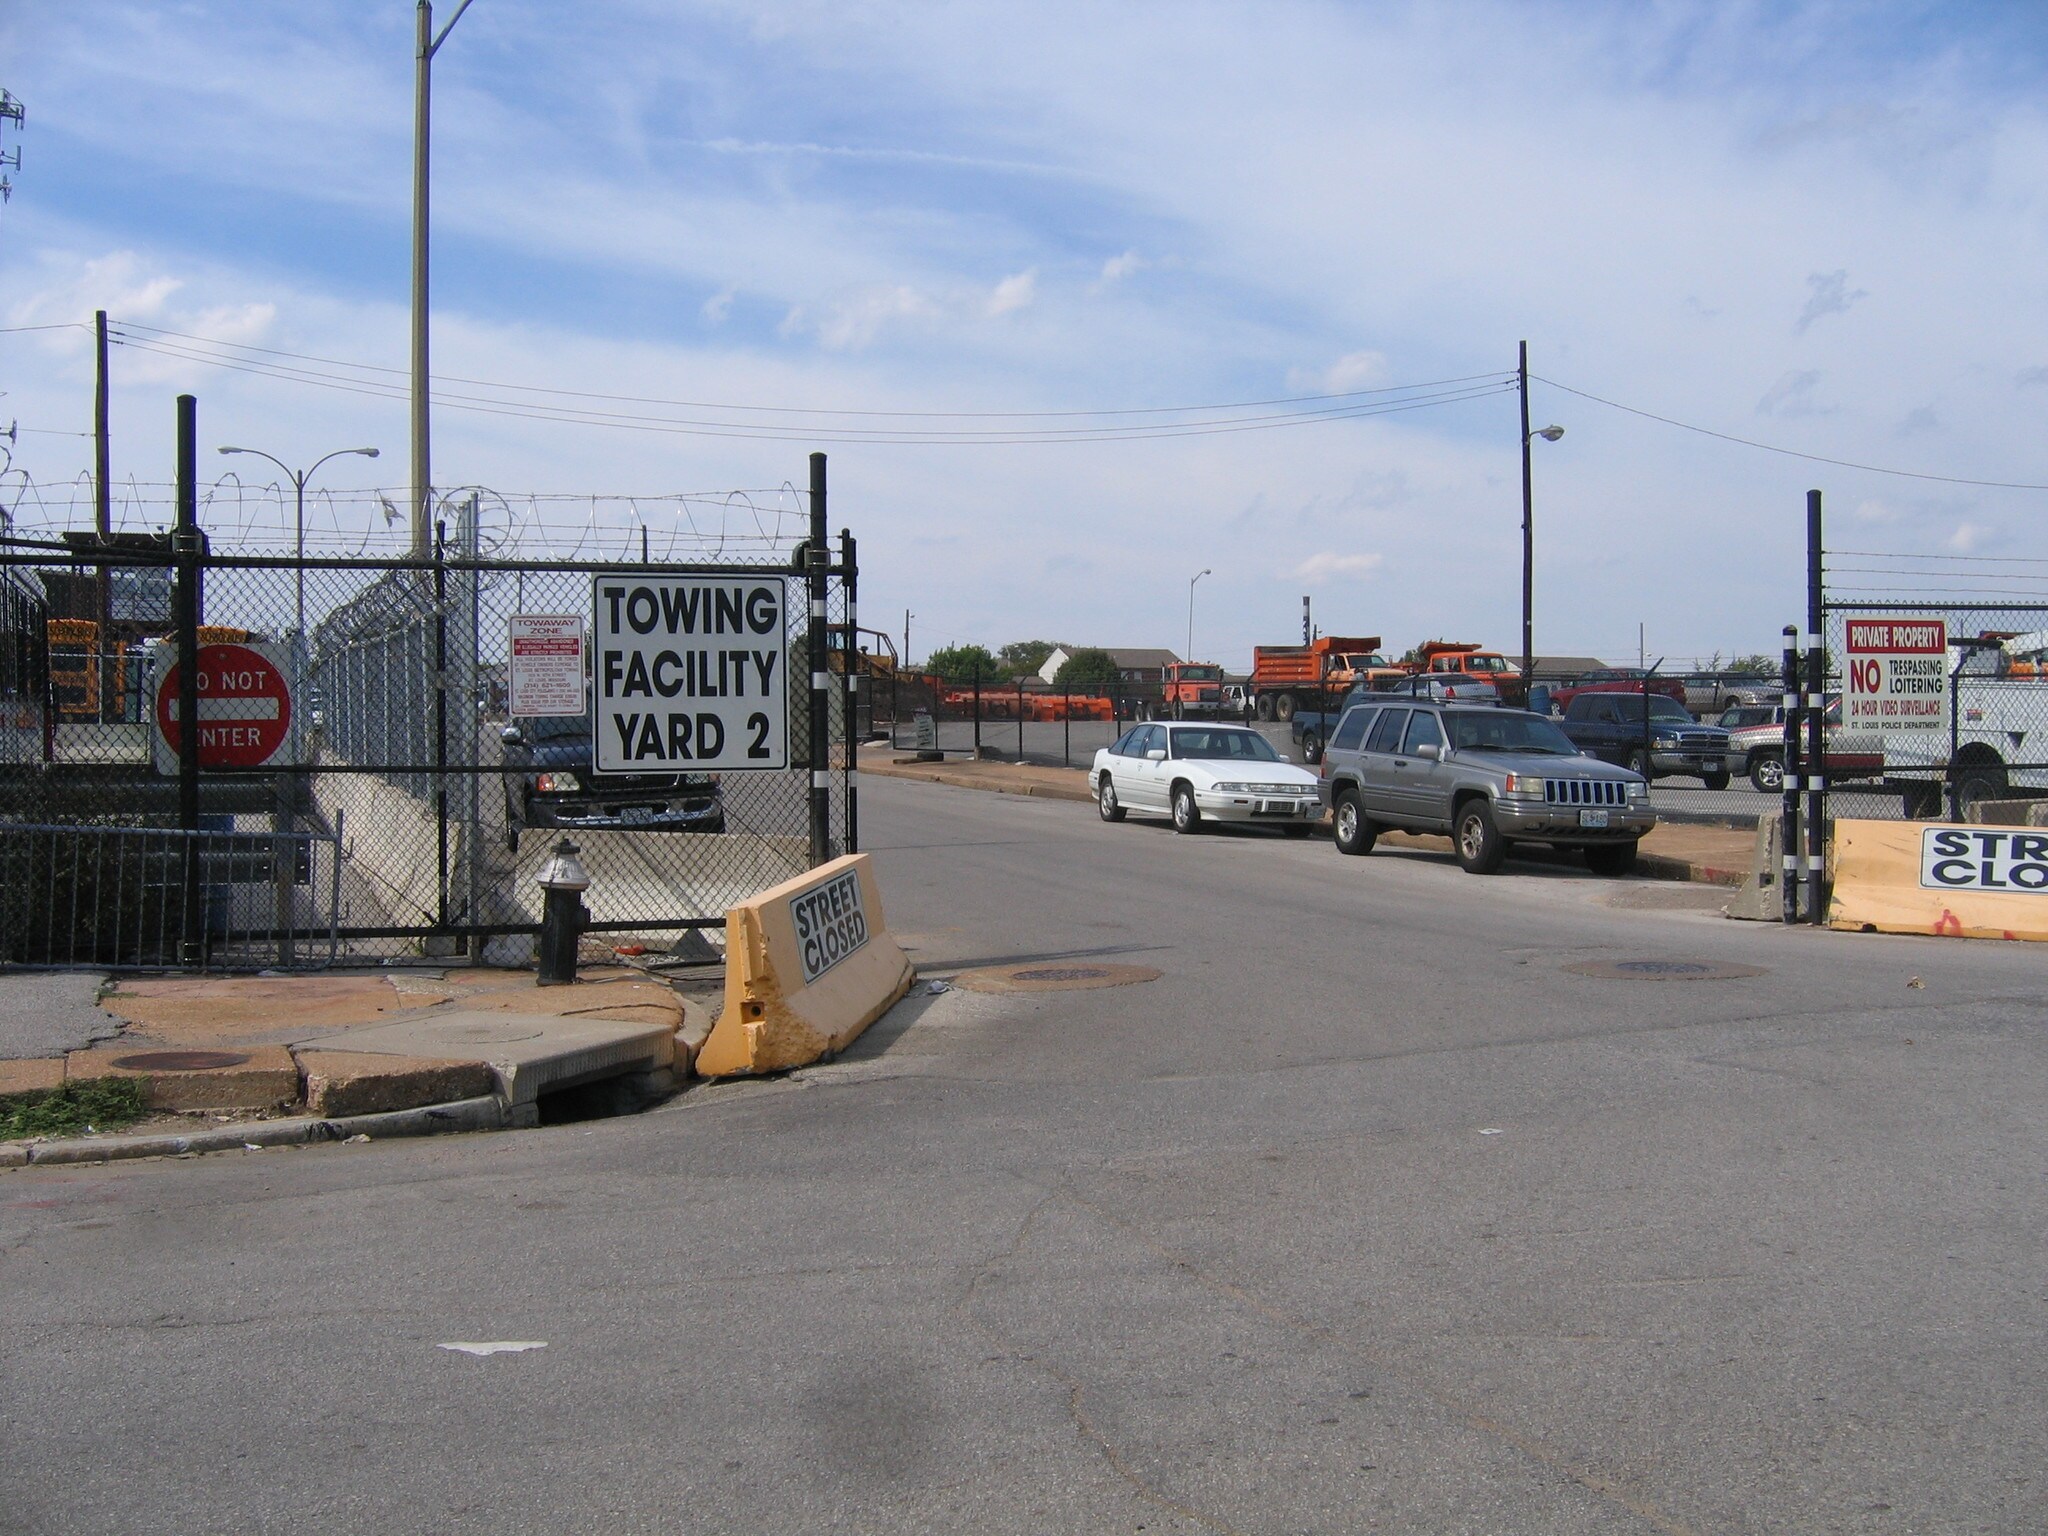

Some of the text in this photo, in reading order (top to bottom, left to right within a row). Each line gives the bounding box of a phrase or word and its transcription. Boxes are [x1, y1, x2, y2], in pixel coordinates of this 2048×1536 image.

[603, 587, 778, 635] TOWING
[516, 619, 575, 627] TOWAWAY
[1851, 626, 1940, 648] PRIVATE PROPERTY
[605, 650, 778, 698] FACILITY
[1850, 659, 1881, 694] NO
[1889, 660, 1942, 676] TRESPASSING
[222, 671, 266, 690] NOT
[1889, 678, 1943, 694] LOITERING
[1851, 700, 1941, 716] 24 HOUR VIDEO SURVEILLANCE
[196, 727, 261, 747] NTER
[613, 712, 771, 760] YARD 2
[795, 874, 858, 939] STREET
[804, 910, 865, 975] CLOSED
